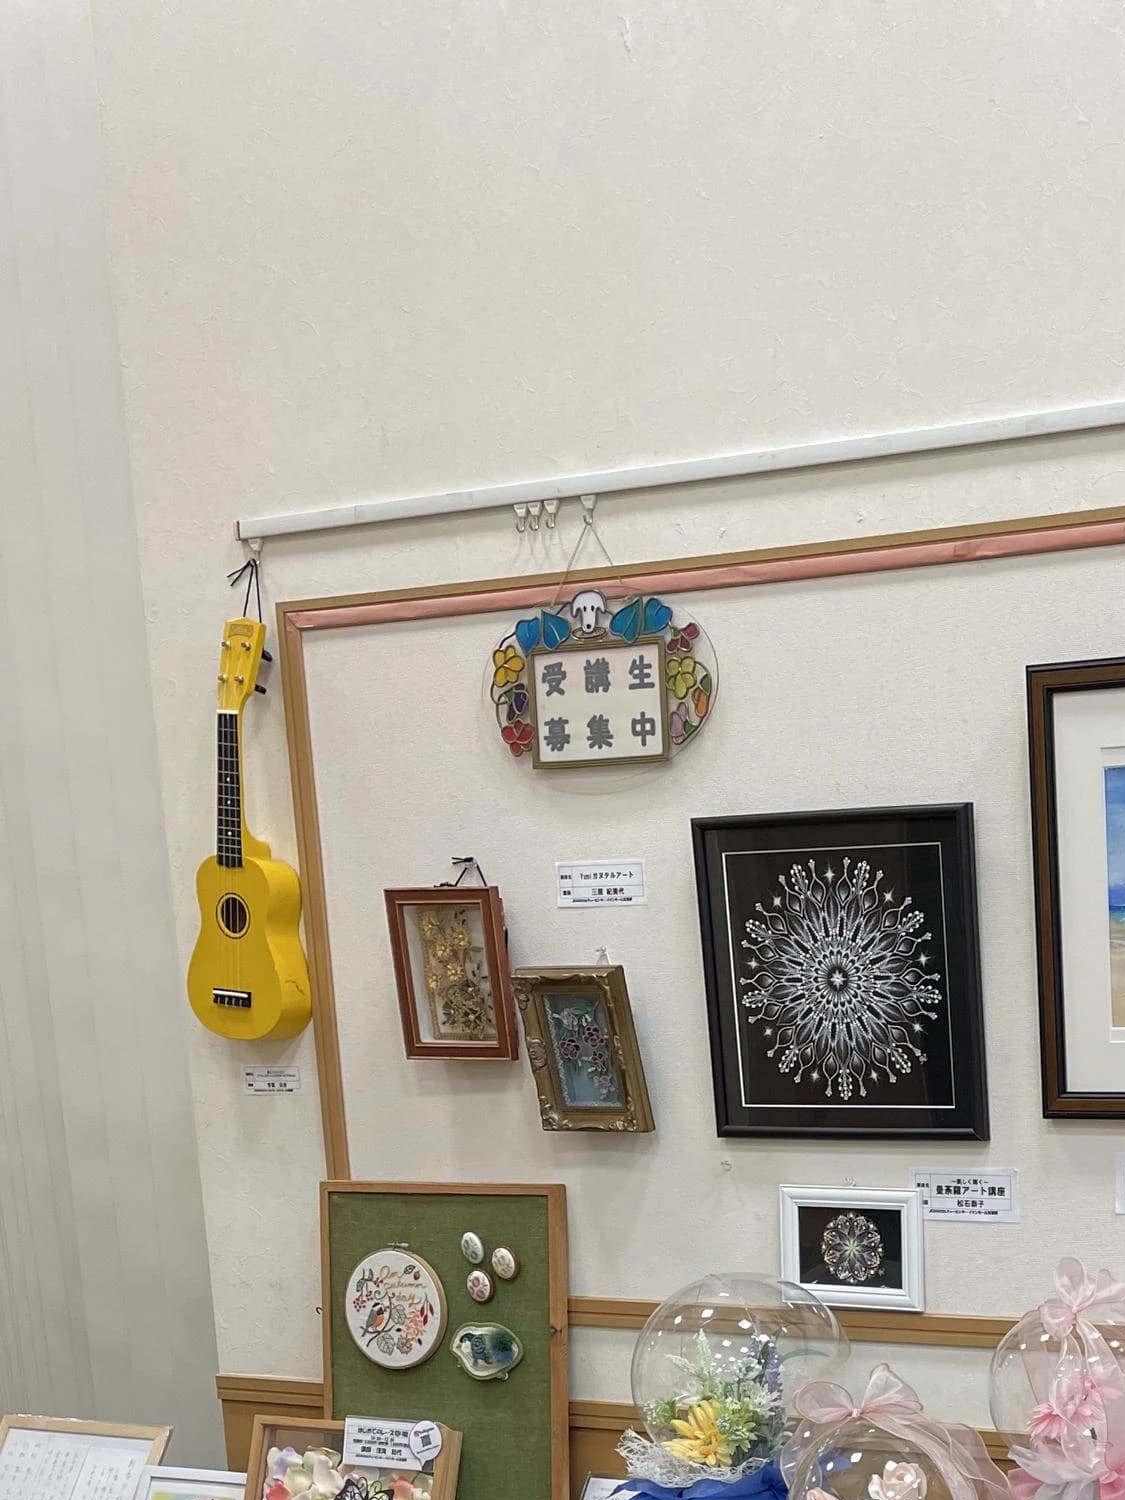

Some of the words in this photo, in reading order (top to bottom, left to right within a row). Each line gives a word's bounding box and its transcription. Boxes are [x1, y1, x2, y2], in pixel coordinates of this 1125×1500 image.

[542, 655, 655, 697] 受講生
[544, 711, 656, 752] 募集中
